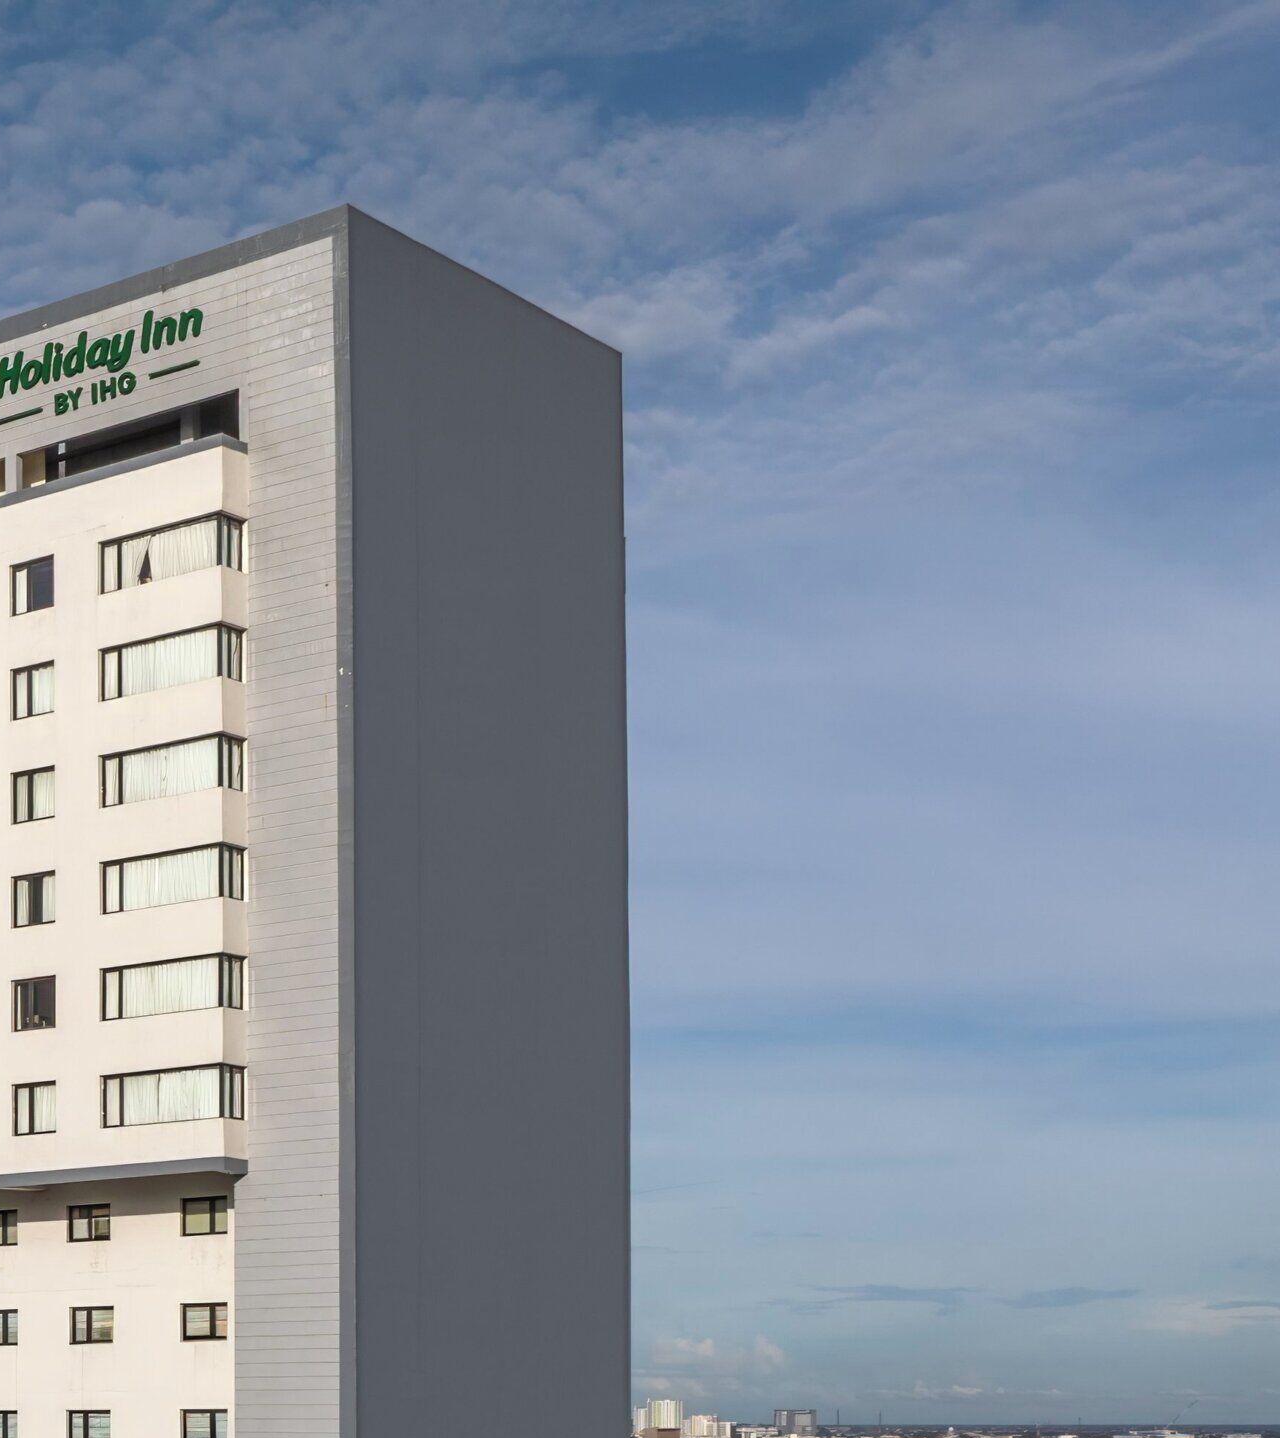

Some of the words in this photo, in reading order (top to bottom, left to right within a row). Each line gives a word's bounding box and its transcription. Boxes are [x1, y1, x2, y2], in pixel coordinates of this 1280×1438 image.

[140, 307, 203, 354] Inn
[53, 385, 81, 416] BY
[90, 371, 137, 406] IHG
